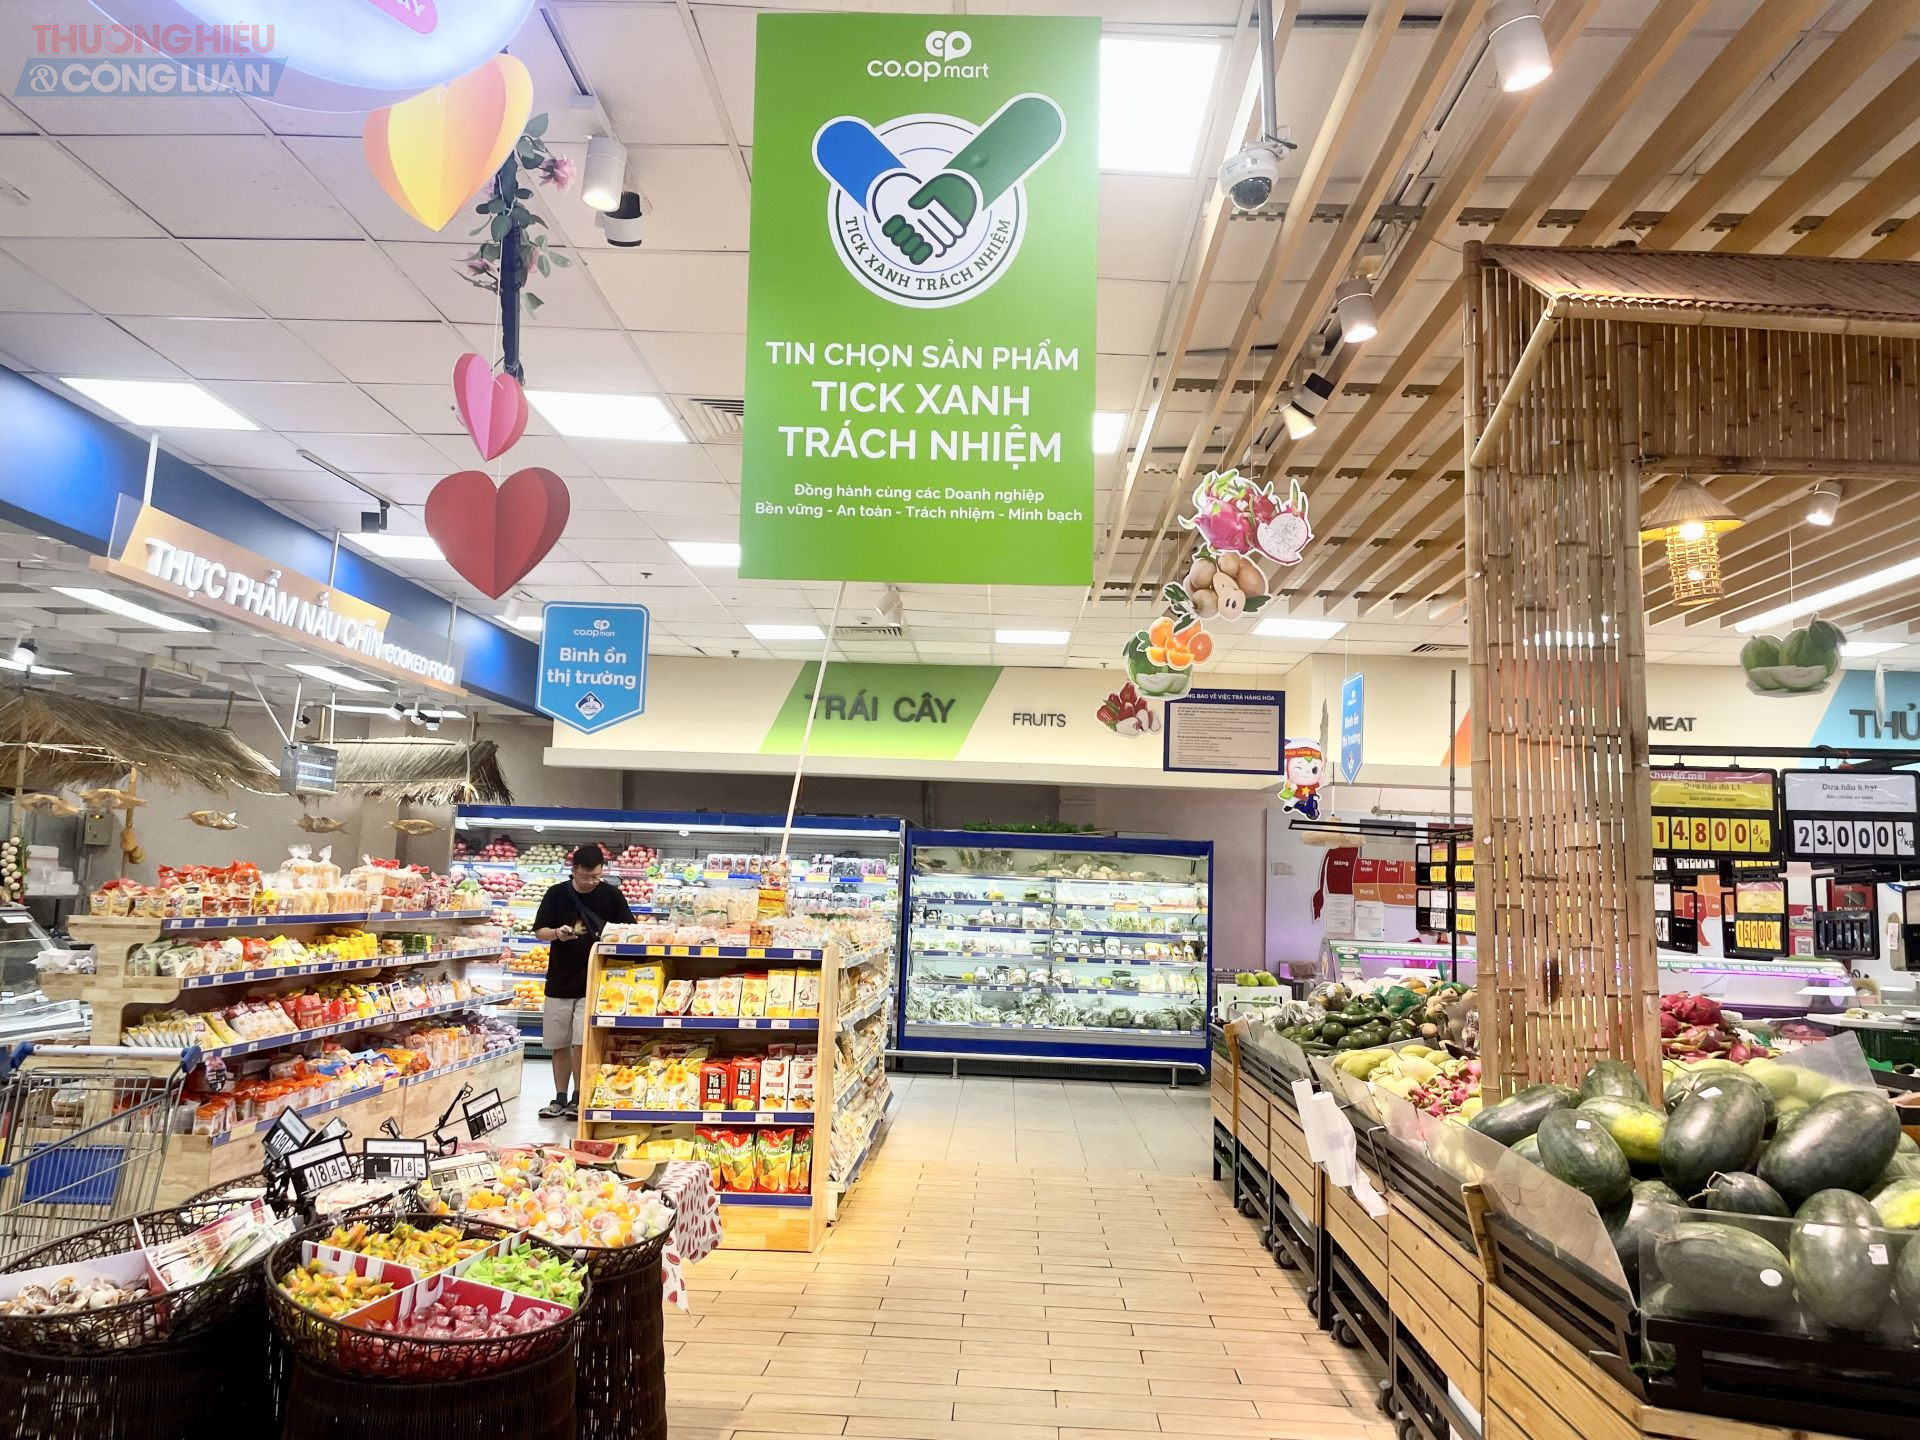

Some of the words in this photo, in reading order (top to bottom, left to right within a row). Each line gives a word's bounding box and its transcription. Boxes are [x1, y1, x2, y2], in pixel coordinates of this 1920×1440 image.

[845, 215, 868, 257] TICK
[864, 253, 911, 288] XANH
[915, 268, 974, 291] TRÁCH
[974, 218, 1011, 272] NHIỆM
[765, 341, 815, 365] TIN
[824, 343, 913, 373] CHỌN
[921, 338, 983, 369] SẢN
[992, 338, 1079, 371] PHẨM
[811, 380, 905, 414] TICK
[915, 383, 1030, 416] XANH
[778, 420, 917, 460] TRÁCH
[930, 424, 1062, 470] NHIỆM
[794, 483, 833, 501] Đồng
[836, 485, 872, 498] hành
[875, 486, 912, 501] cùng
[915, 486, 941, 500] các
[944, 487, 991, 500] Doanh
[994, 487, 1045, 504] nghiệp
[755, 500, 784, 515] Bền
[787, 502, 823, 519] vững
[836, 505, 856, 517] An
[859, 506, 892, 517] toàn
[905, 506, 947, 518] Trách
[950, 507, 995, 522] nhiệm
[1008, 508, 1043, 520] Minh
[1046, 509, 1083, 524] bạch
[144, 537, 227, 599] THỰC
[226, 568, 300, 628] PHẨM
[427, 659, 456, 685] FOOD
[559, 647, 600, 663] Bình
[603, 647, 627, 664] ổn
[546, 668, 571, 687] thị
[574, 671, 637, 690] trường
[892, 691, 956, 723] CÂY
[1012, 712, 1067, 728] FRUITS
[1647, 716, 1697, 732] MEAT
